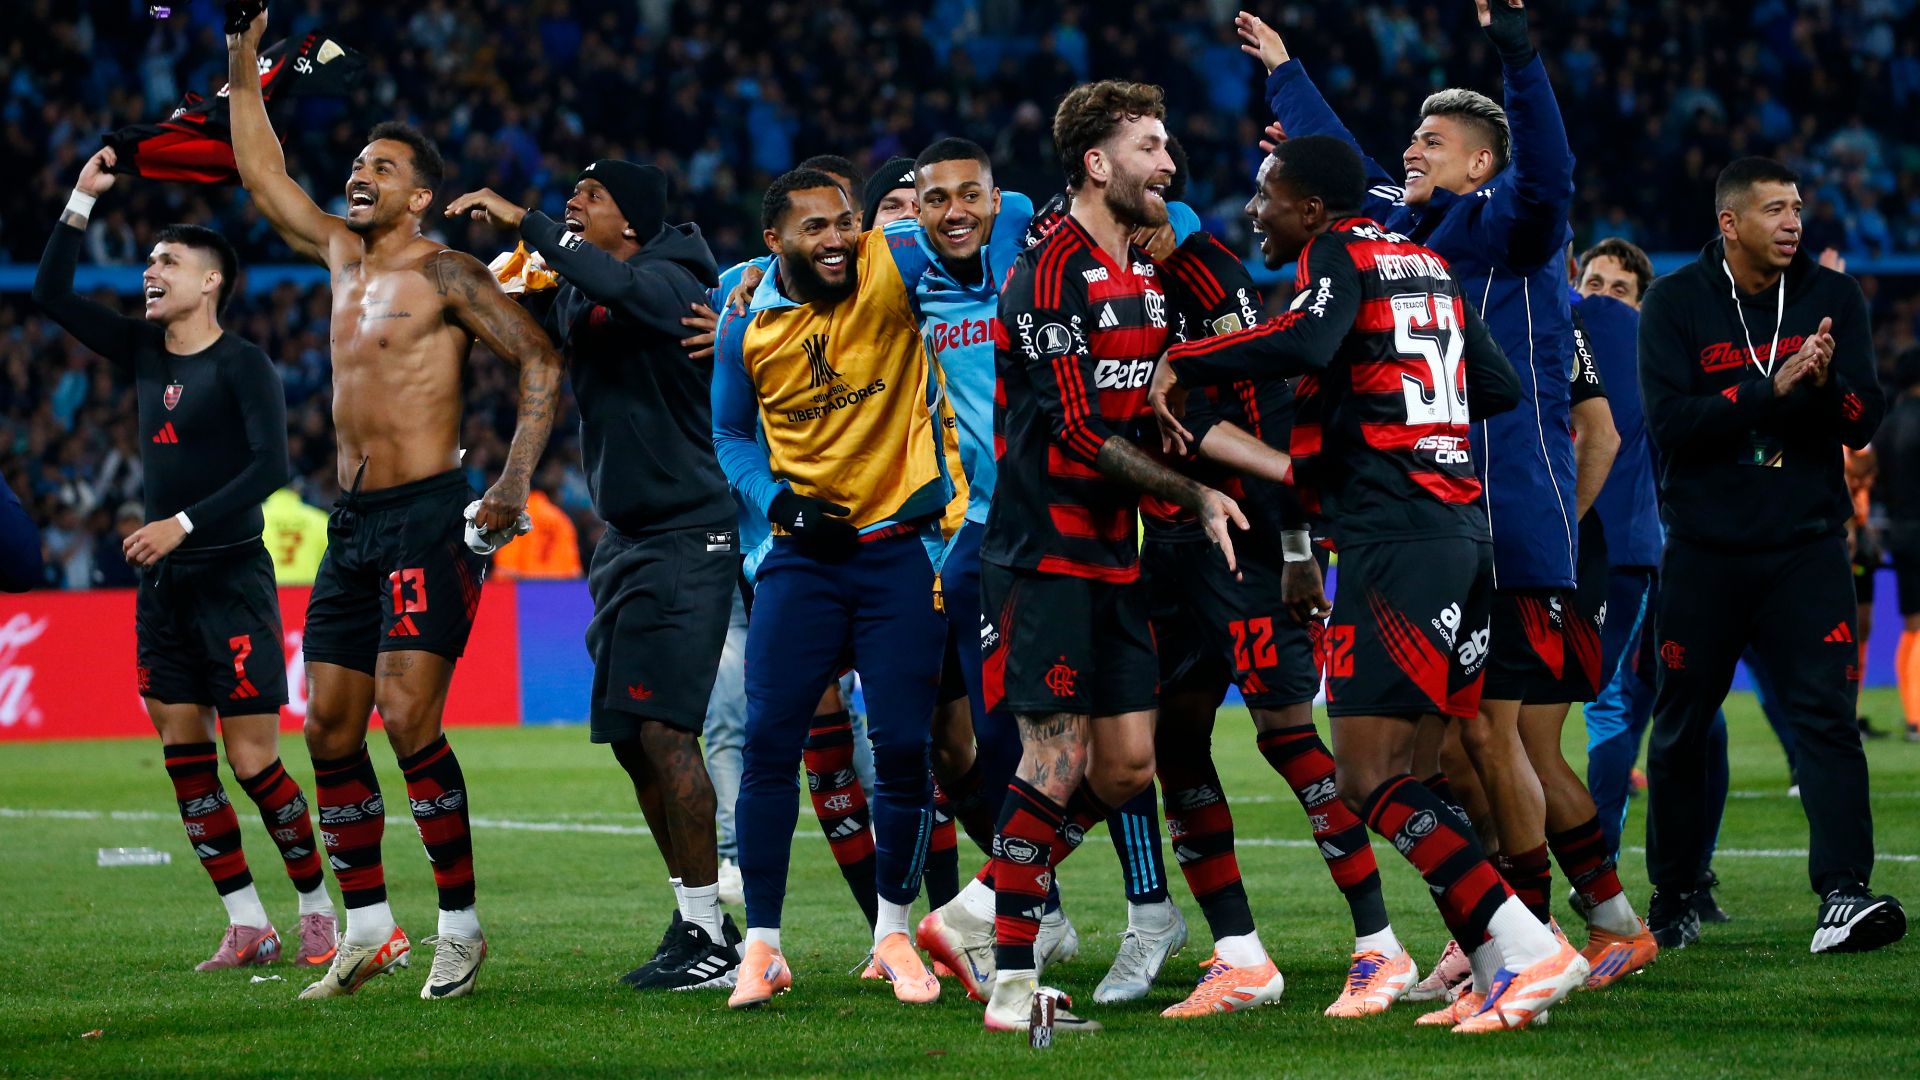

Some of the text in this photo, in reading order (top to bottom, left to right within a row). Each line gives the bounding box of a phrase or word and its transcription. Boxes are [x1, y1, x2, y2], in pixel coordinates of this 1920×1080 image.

[1236, 288, 1257, 330] opee
[1402, 301, 1425, 309] TEXACO
[1573, 329, 1599, 385] Shopee
[787, 378, 886, 423] LIBERTADORES
[389, 568, 428, 615] 13
[229, 634, 252, 679] 7
[1228, 616, 1278, 671] 22
